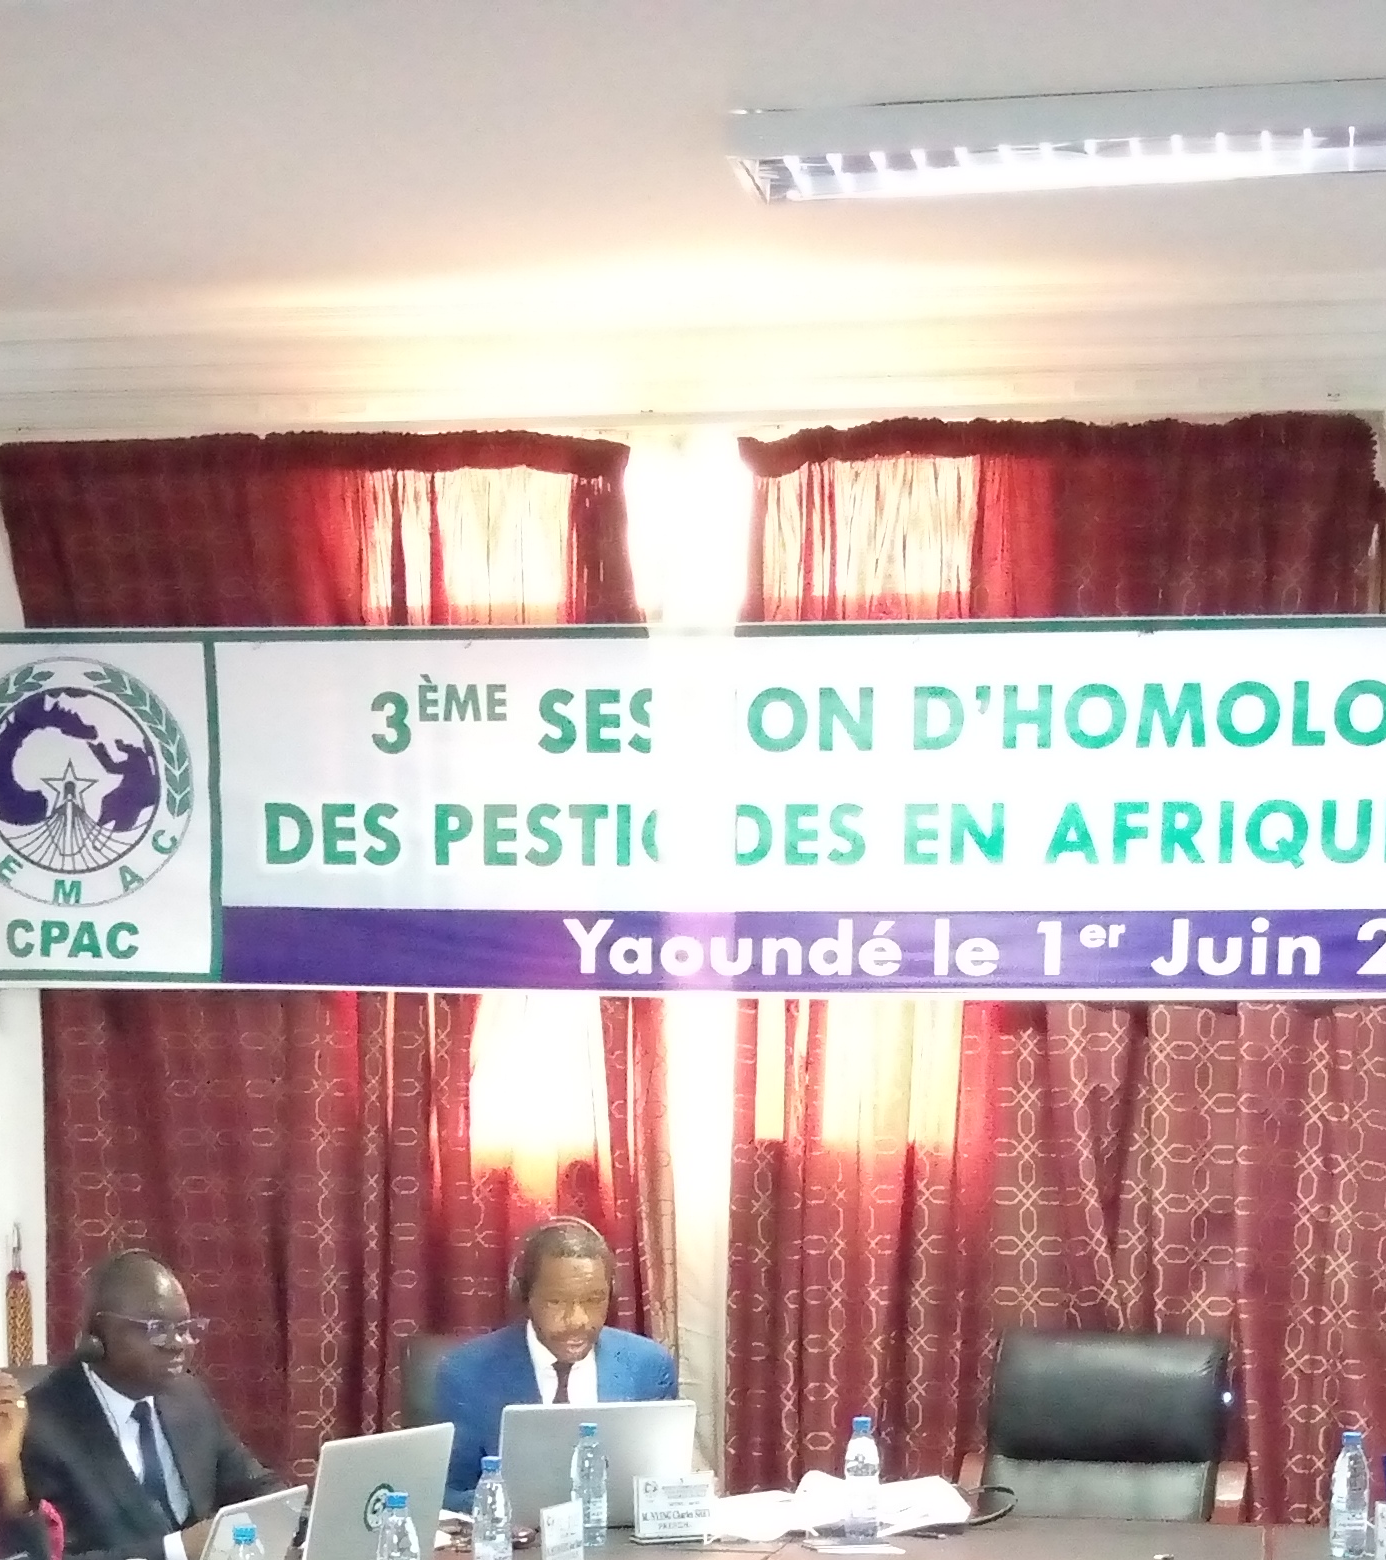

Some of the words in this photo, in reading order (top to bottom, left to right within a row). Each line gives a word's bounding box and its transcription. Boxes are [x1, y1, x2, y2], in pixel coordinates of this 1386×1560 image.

[370, 674, 508, 754] 3ÈME
[539, 687, 874, 754] SESON
[263, 801, 402, 866] DES
[433, 801, 867, 866] PESTIDES
[904, 800, 1007, 865] EN
[6, 918, 140, 959] CPAC
[563, 919, 902, 977] Yaoundé
[934, 918, 999, 976] le
[1037, 920, 1126, 976] 1er
[1151, 917, 1320, 977] Juin
